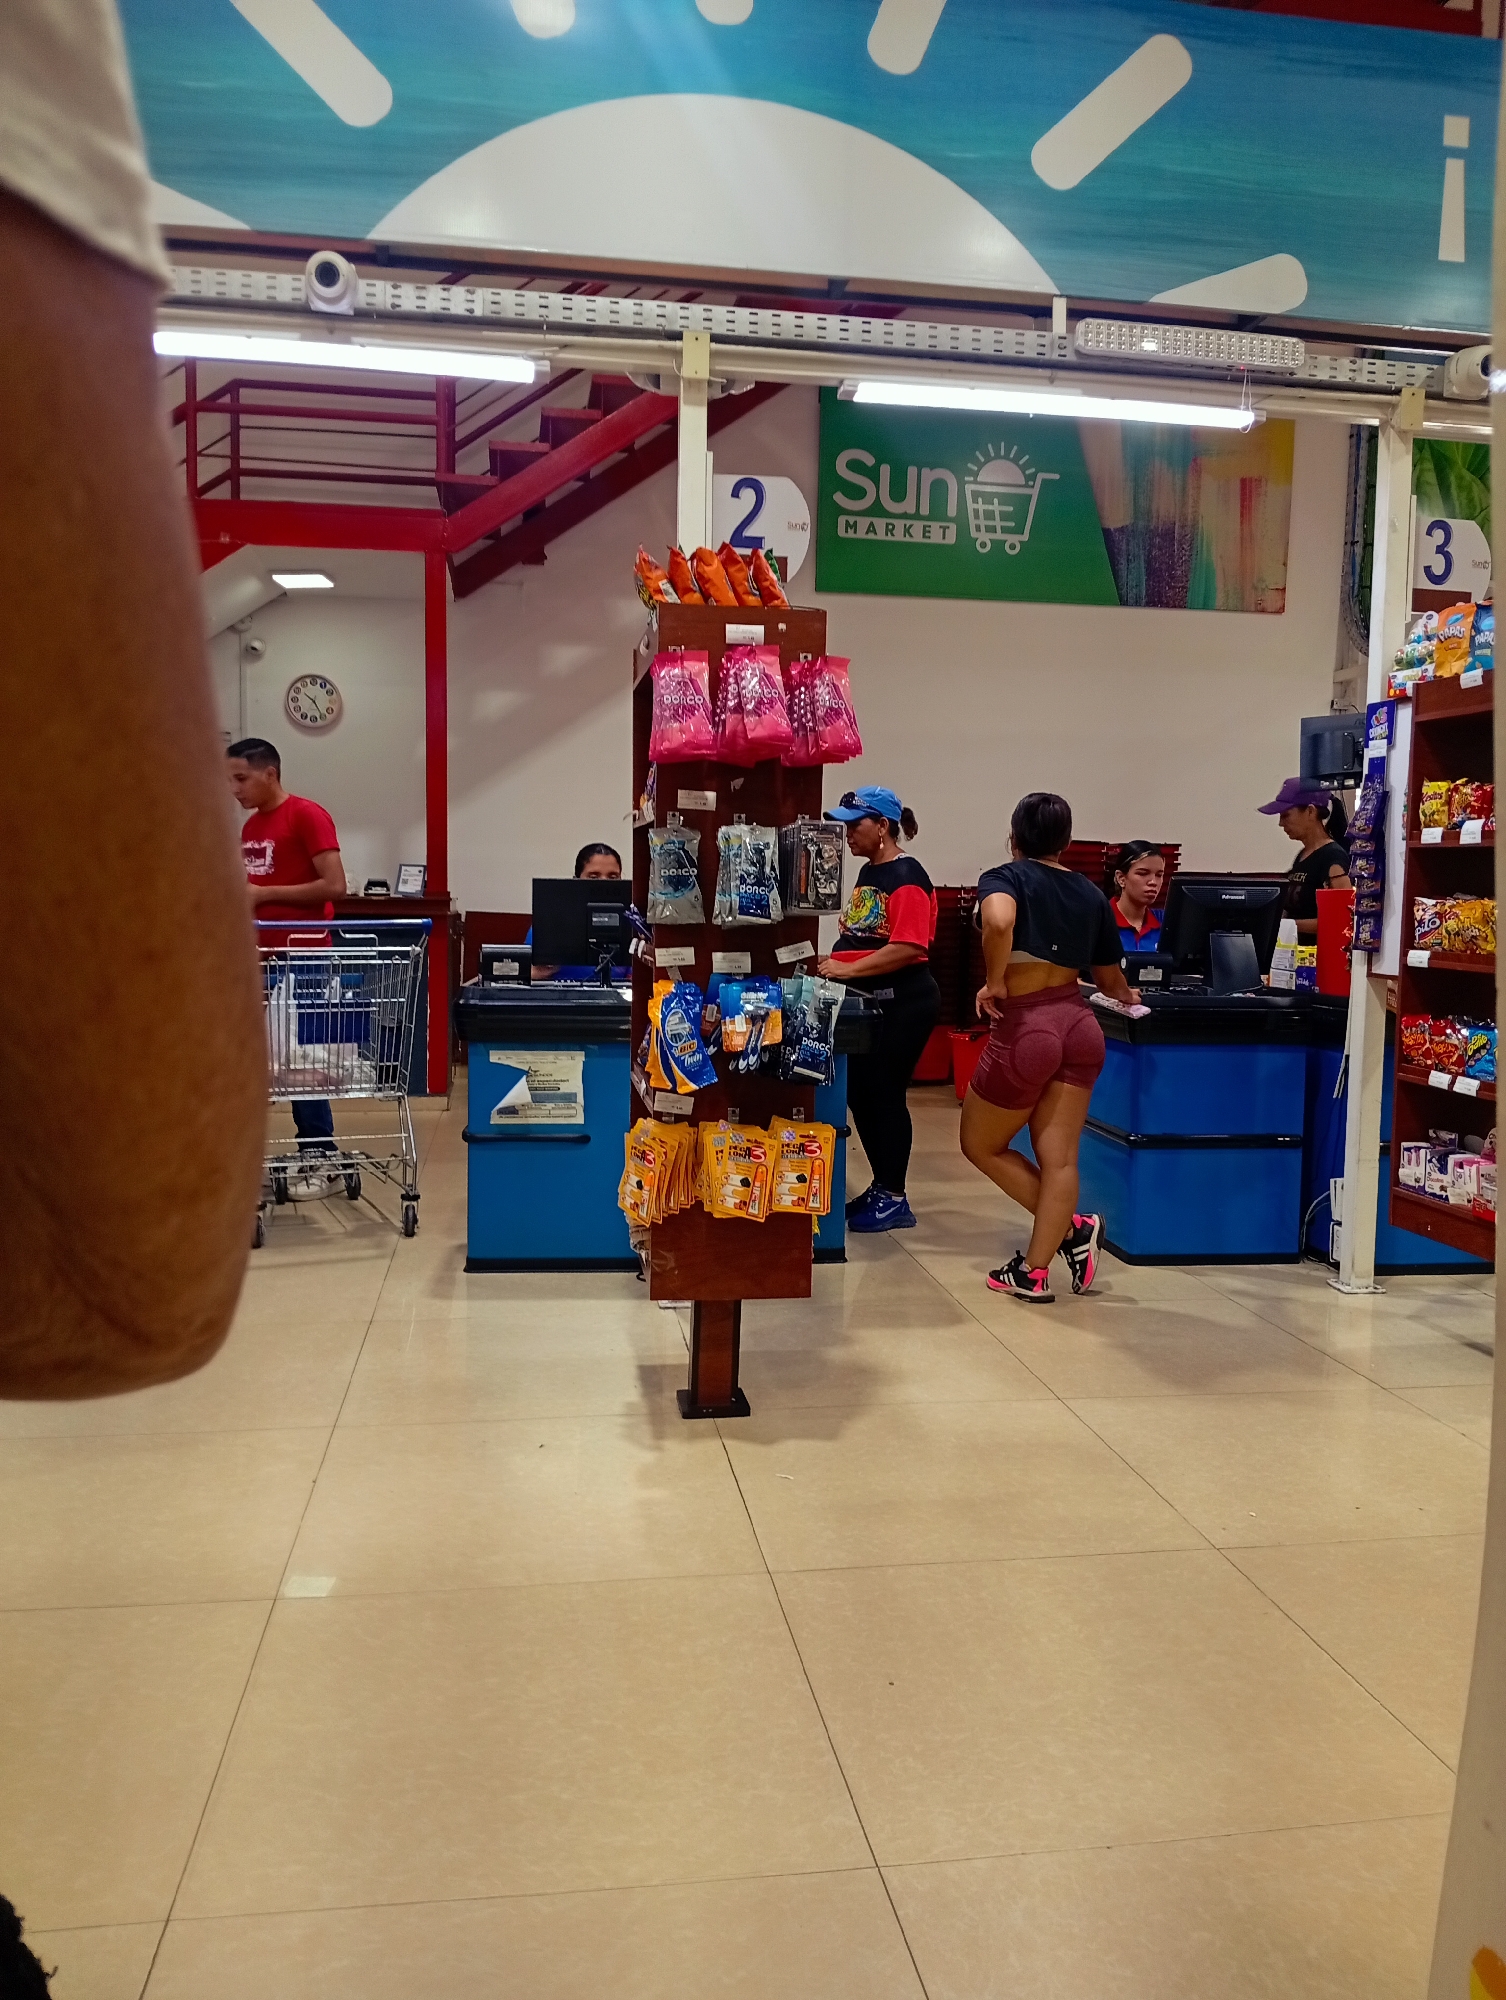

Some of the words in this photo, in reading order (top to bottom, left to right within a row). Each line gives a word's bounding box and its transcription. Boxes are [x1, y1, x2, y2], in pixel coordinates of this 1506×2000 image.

[832, 448, 958, 517] Sun
[729, 477, 766, 549] 2
[844, 519, 950, 541] MARKET
[1422, 519, 1453, 586] 3
[1437, 625, 1465, 642] PAPAS
[663, 694, 704, 704] DORCO
[660, 867, 698, 876] DORCO
[761, 894, 768, 905] 2
[679, 1041, 697, 1054] BIC
[681, 1052, 703, 1067] Twin
[819, 1050, 827, 1061] 2
[750, 1146, 765, 1162] 3
[804, 1142, 820, 1157] 3
